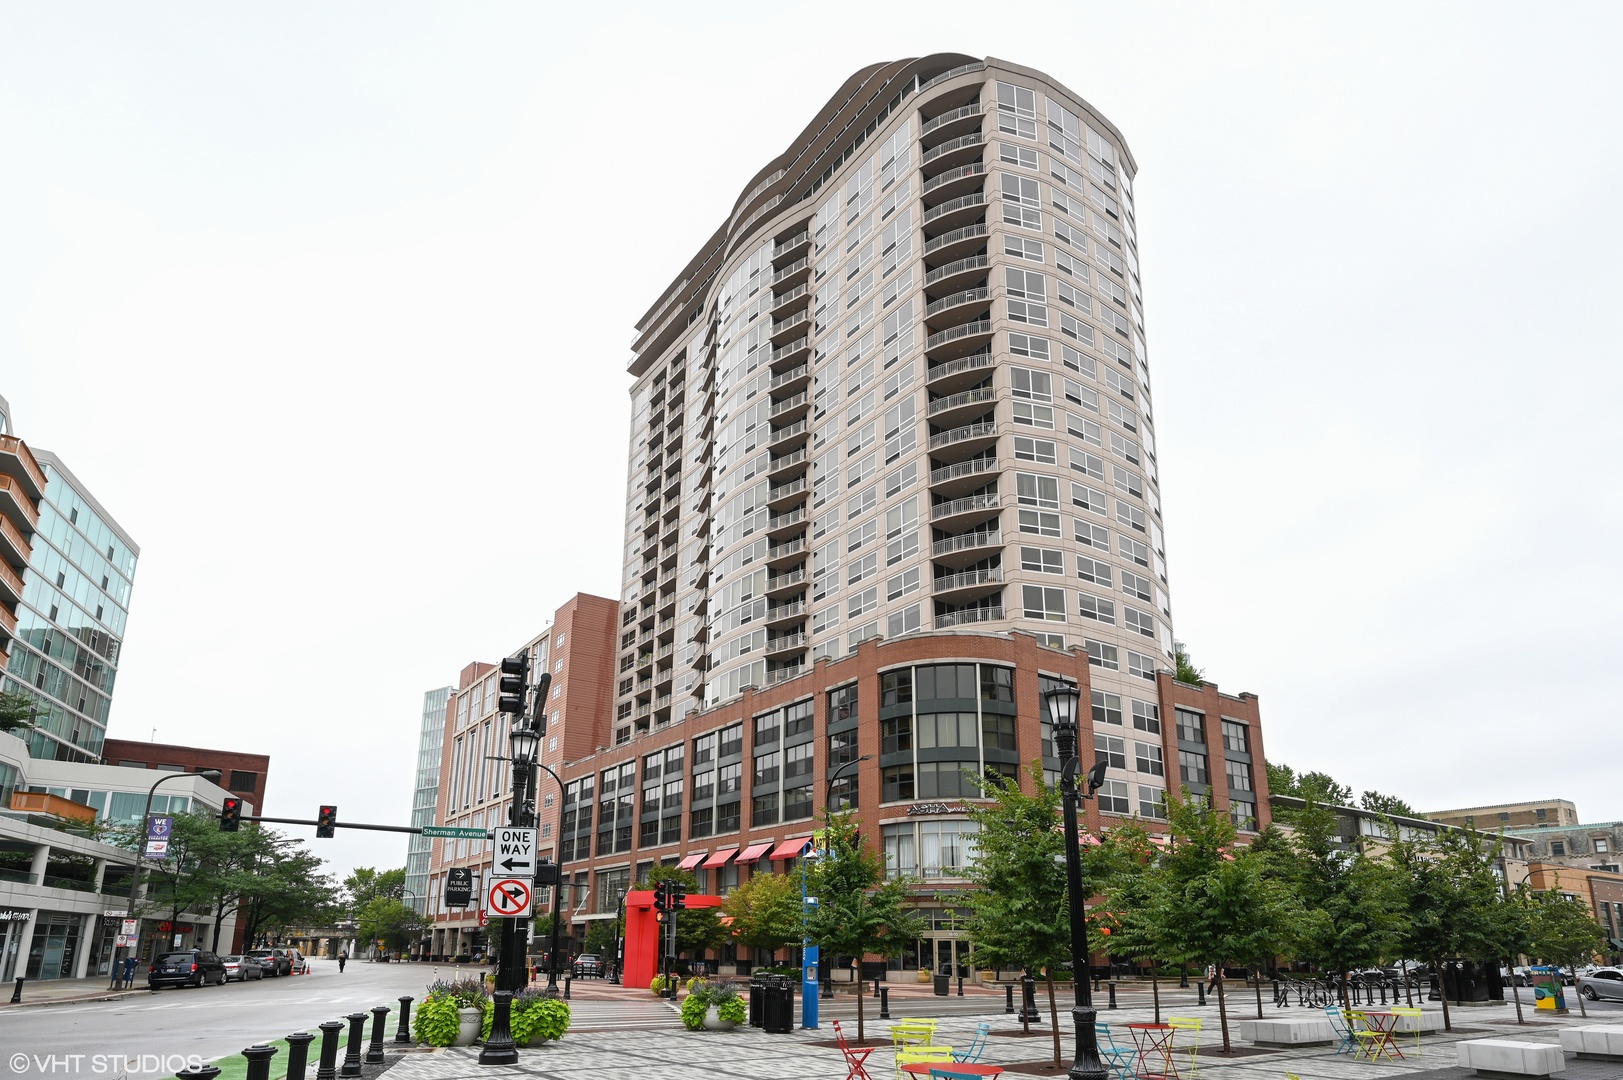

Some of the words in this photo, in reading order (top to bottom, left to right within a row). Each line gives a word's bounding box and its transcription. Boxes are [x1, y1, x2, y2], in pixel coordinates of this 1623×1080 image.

[908, 803, 951, 816] ASHA
[424, 828, 456, 836] Sherman
[458, 829, 486, 838] Avenue
[502, 831, 531, 843] ONE
[500, 844, 531, 856] WAY
